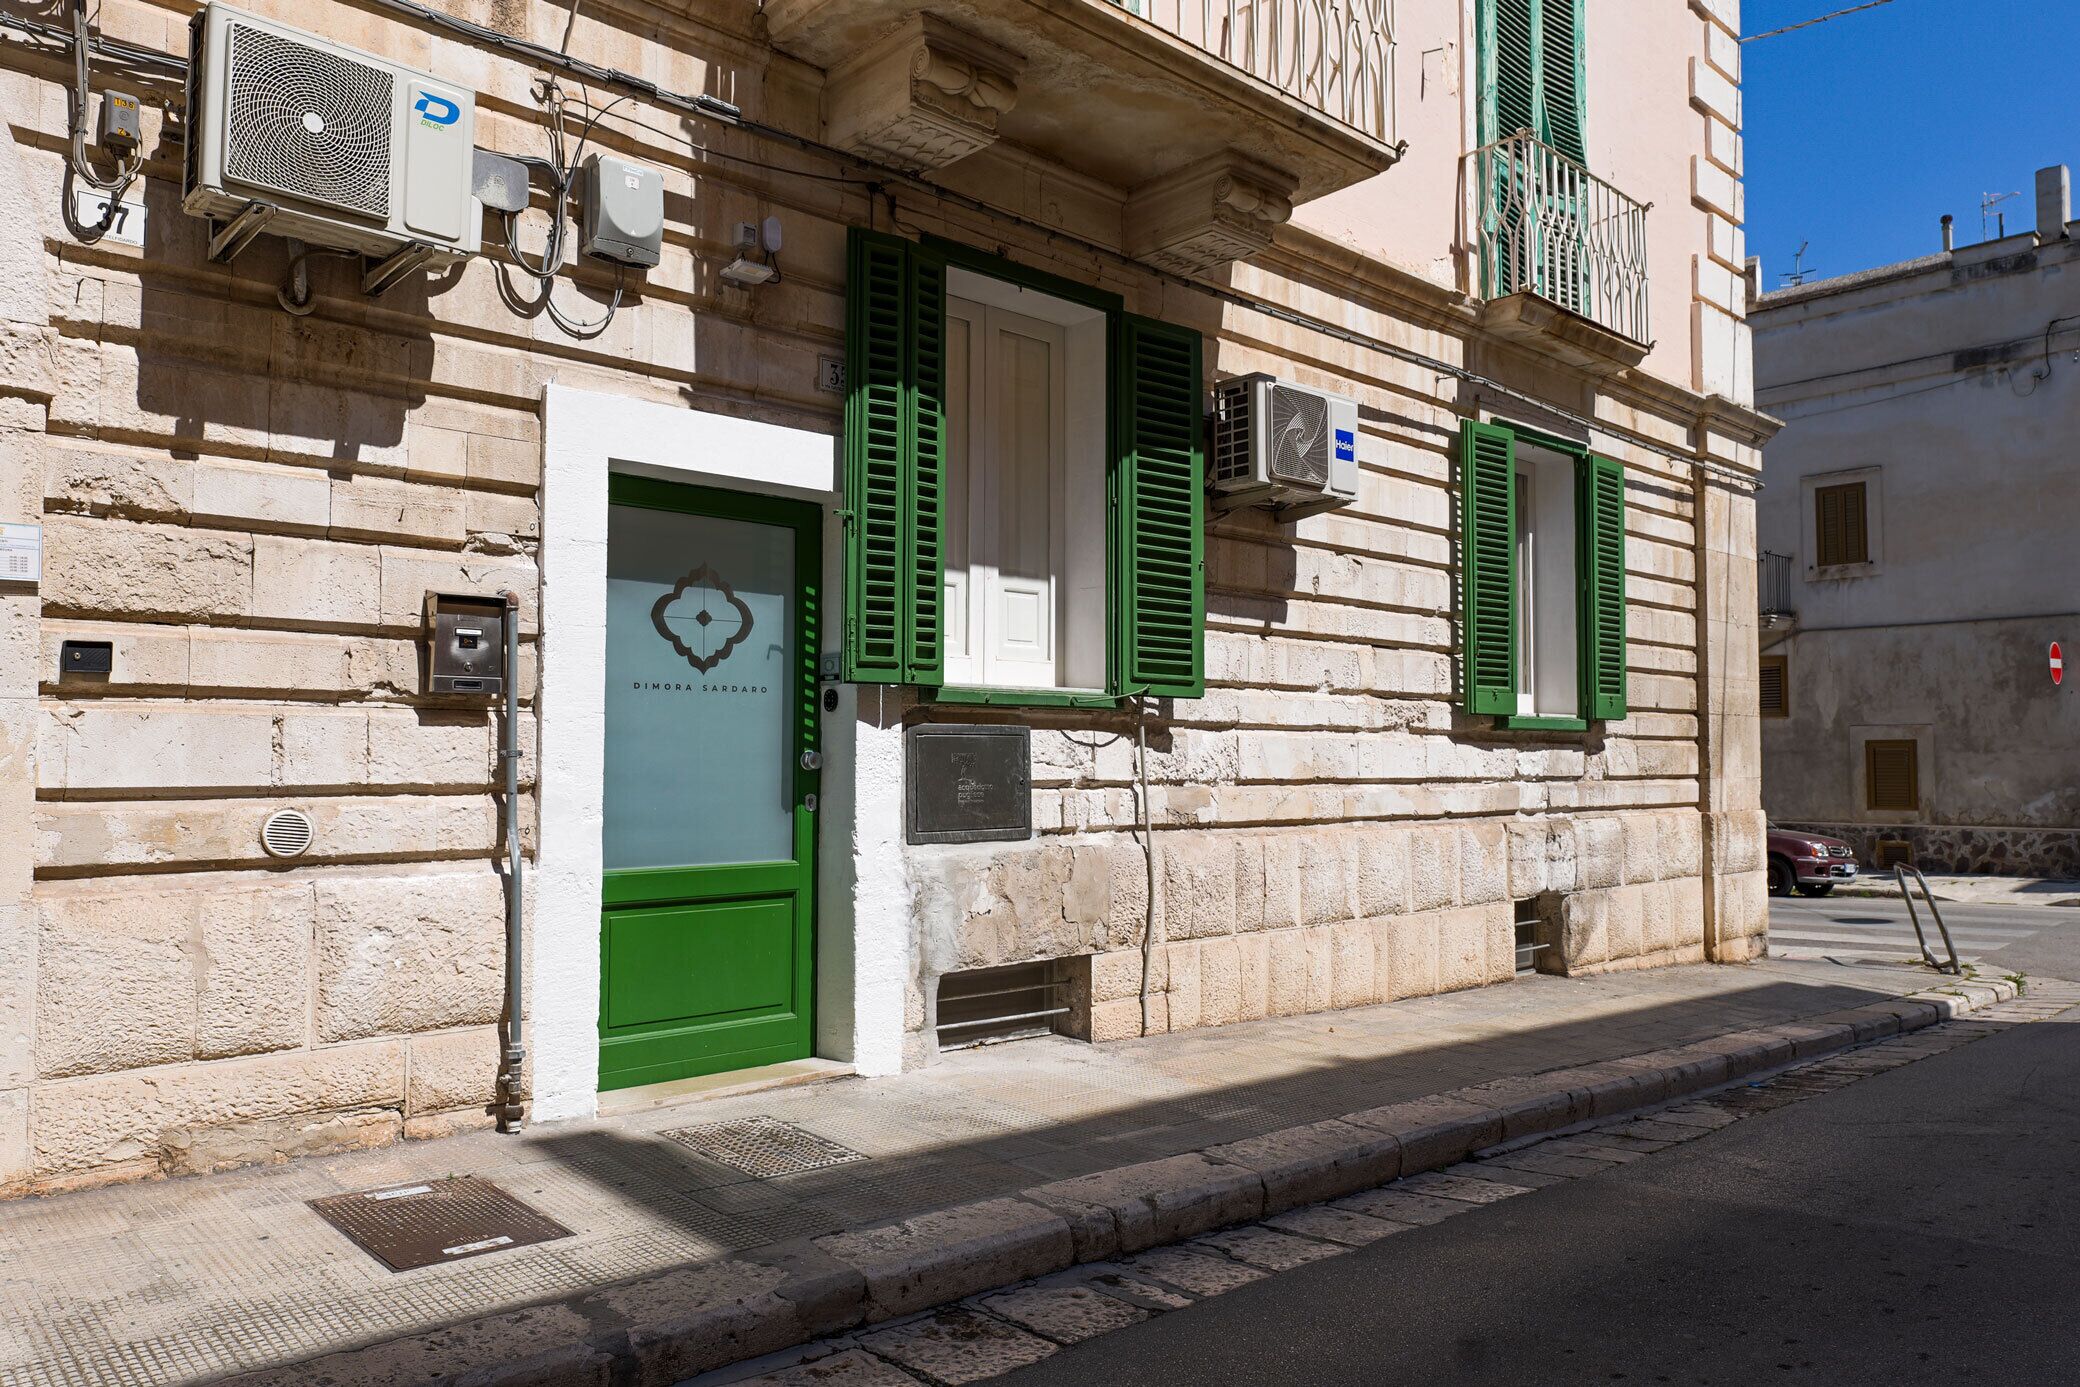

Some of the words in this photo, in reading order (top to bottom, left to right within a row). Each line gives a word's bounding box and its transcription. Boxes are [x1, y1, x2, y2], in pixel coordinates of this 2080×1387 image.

[420, 119, 445, 131] DILOC
[97, 202, 129, 234] 37
[1335, 439, 1354, 452] Haier
[633, 682, 692, 691] DIMORA
[702, 684, 768, 693] SARDARO
